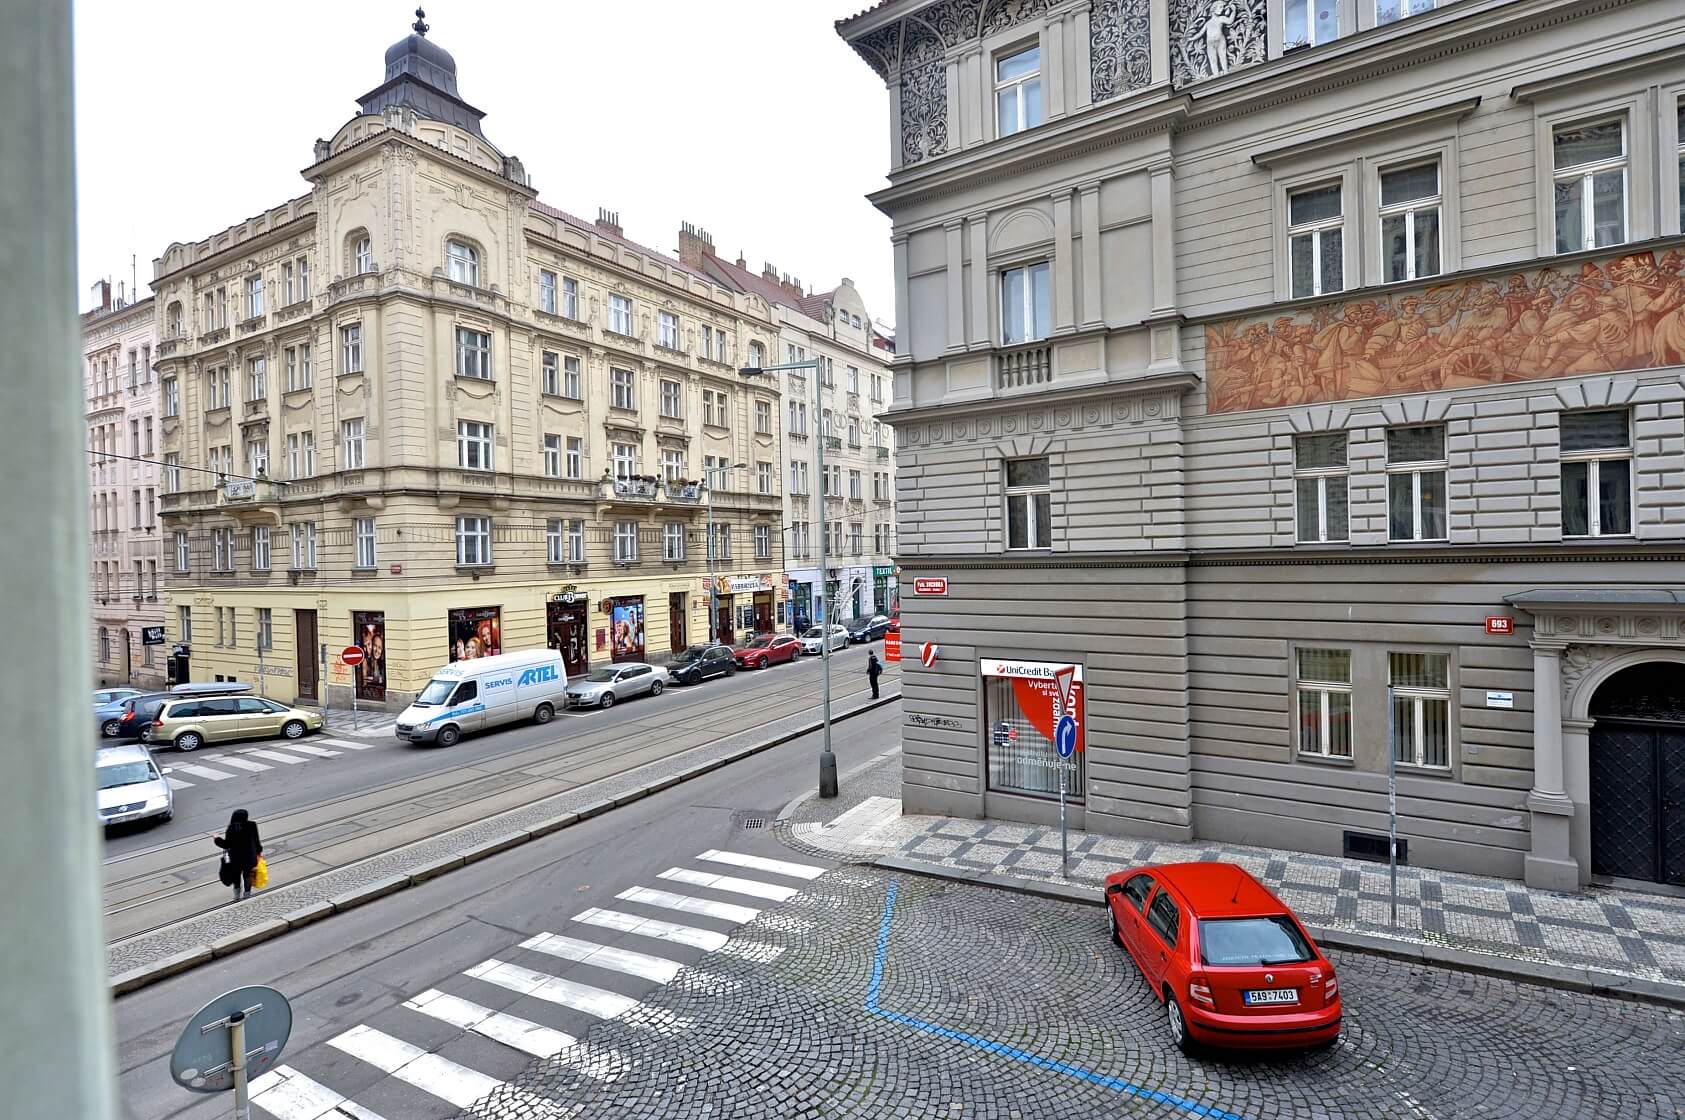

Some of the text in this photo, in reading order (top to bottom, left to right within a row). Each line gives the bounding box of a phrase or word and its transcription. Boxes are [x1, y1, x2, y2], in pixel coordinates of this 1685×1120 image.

[876, 567, 893, 576] TEXTIL
[1491, 619, 1508, 629] 693
[1006, 666, 1042, 676] UniCredit
[484, 664, 559, 690] SERVIS ARTEL
[1251, 990, 1294, 1002] 5A9 7403
